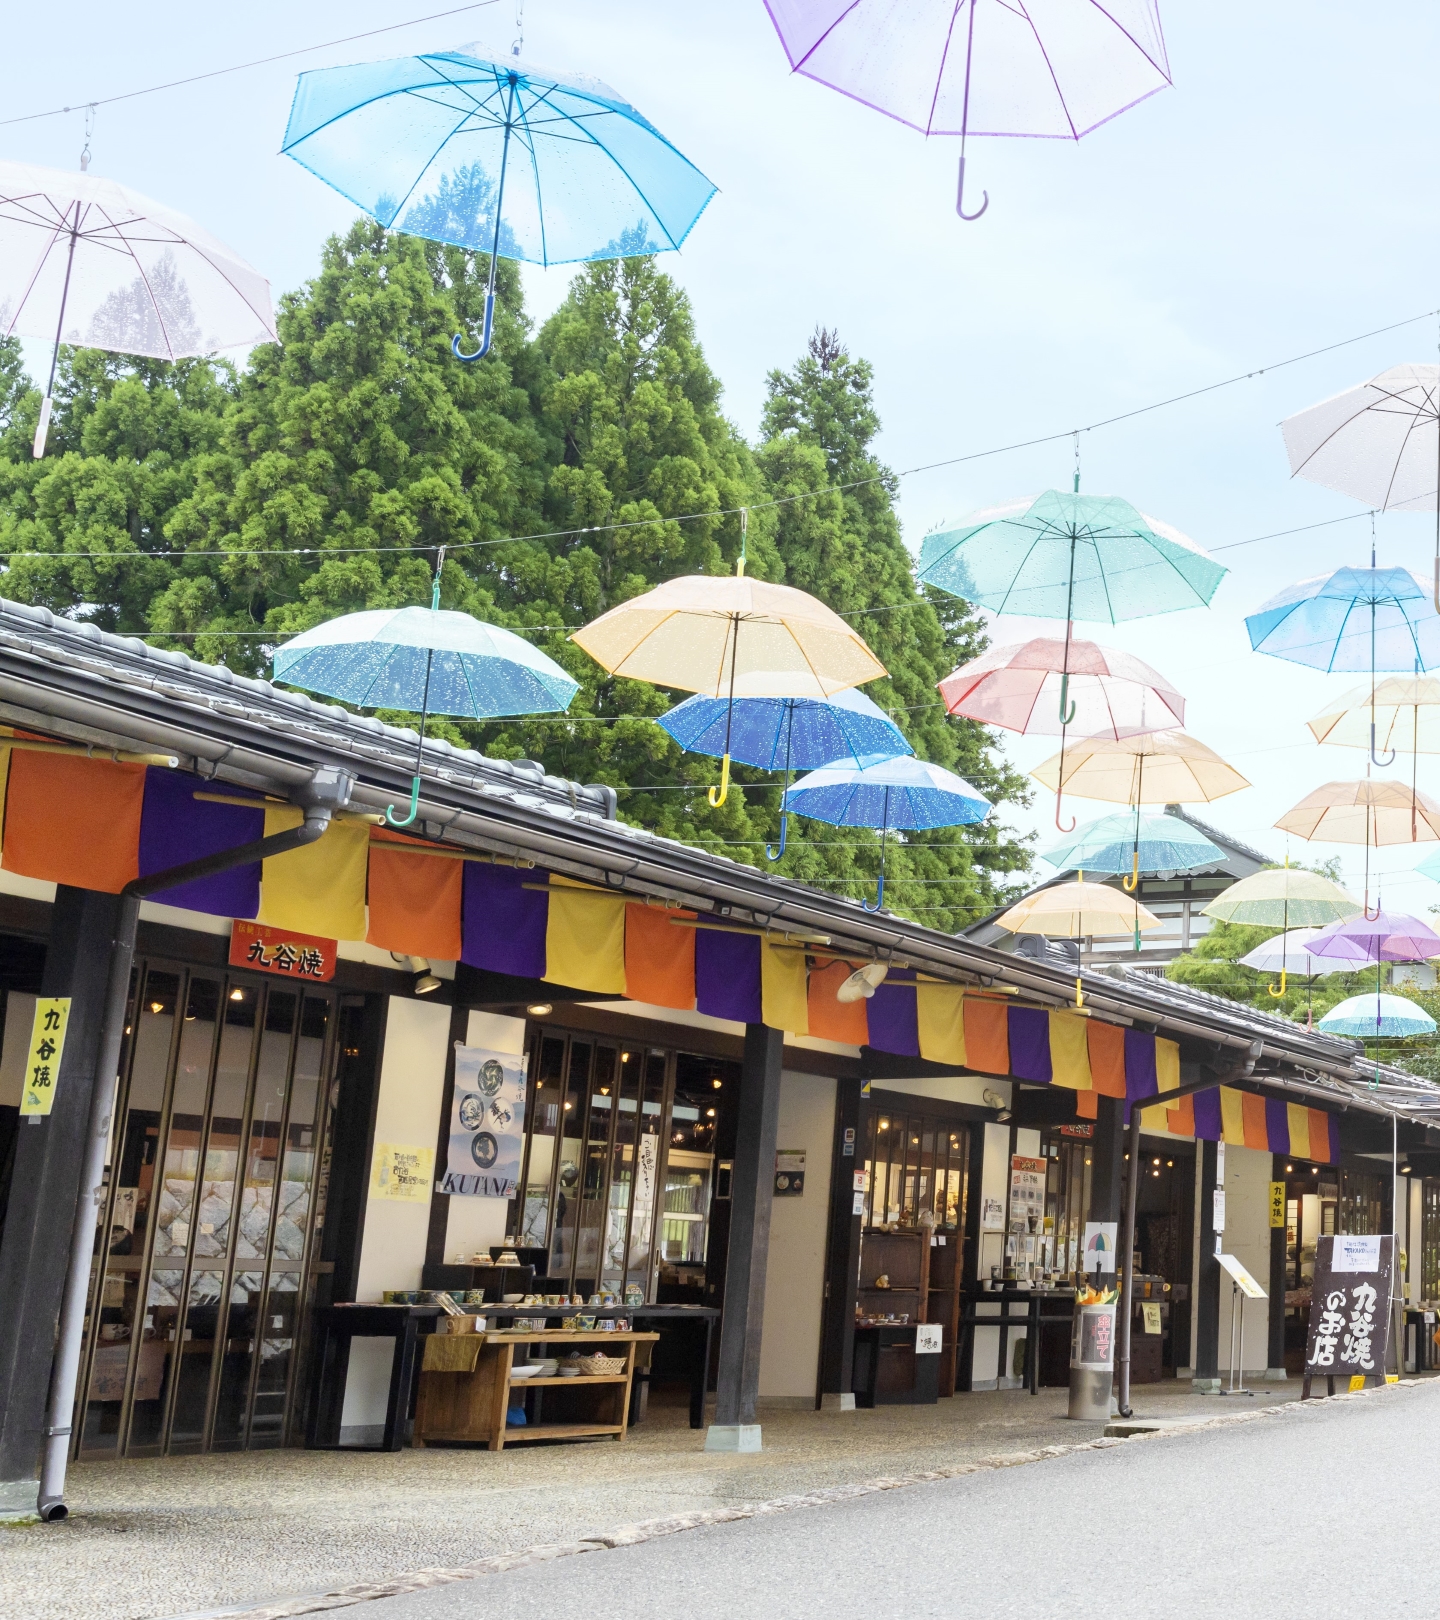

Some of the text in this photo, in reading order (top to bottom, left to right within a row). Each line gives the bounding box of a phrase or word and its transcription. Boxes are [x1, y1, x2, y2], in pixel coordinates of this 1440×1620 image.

[247, 939, 324, 977] 九谷焼
[32, 1008, 60, 1088] 九谷焼
[443, 1173, 509, 1197] KUTANI
[1272, 1186, 1283, 1217] 九谷焼
[1097, 1314, 1111, 1359] 傘立て
[1307, 1290, 1347, 1366] のお店
[1340, 1281, 1377, 1370] 九谷焼
